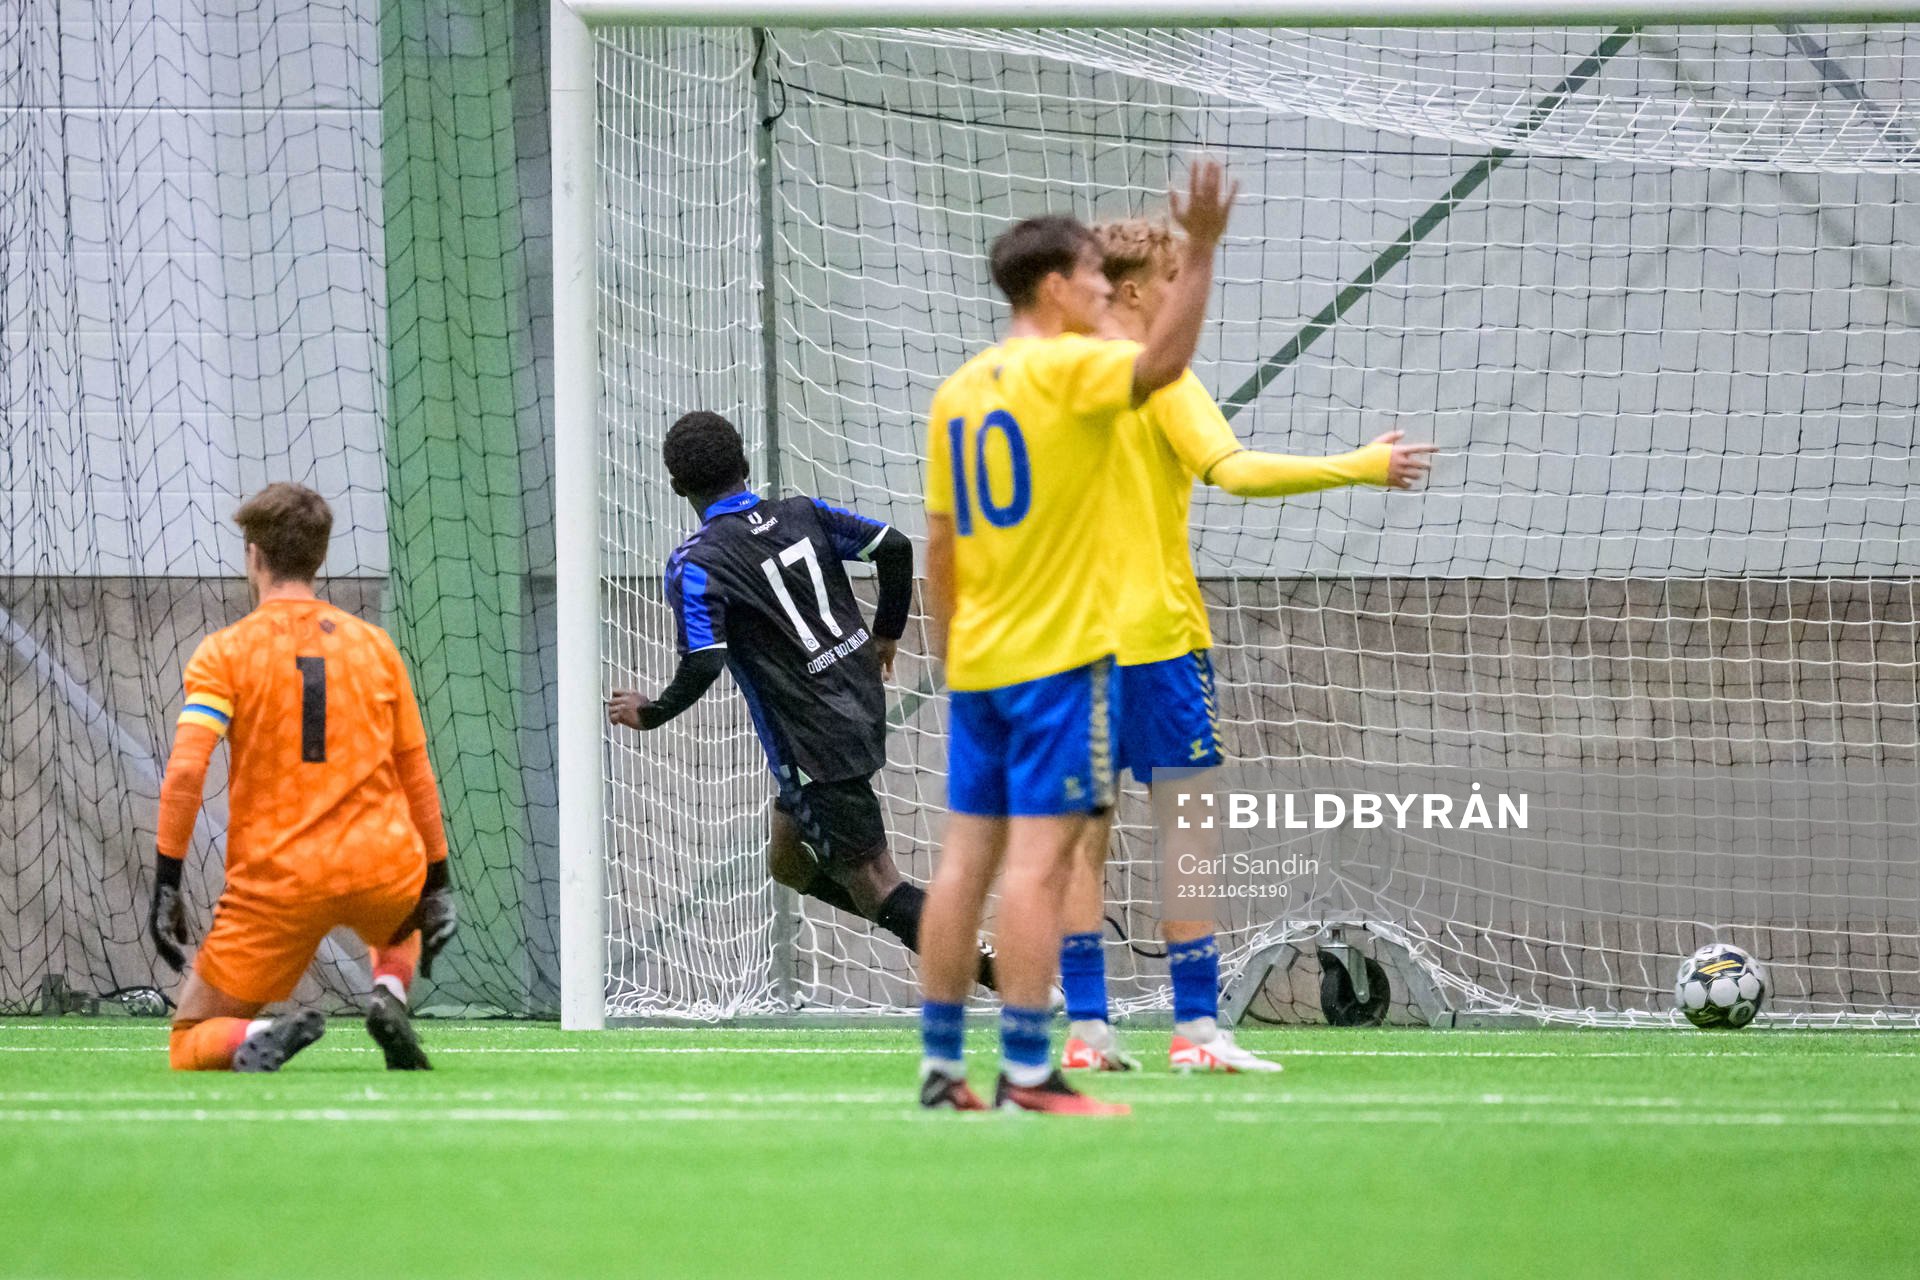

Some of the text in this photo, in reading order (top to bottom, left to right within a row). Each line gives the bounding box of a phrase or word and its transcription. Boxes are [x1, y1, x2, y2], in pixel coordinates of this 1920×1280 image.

[948, 409, 1032, 537] 10
[761, 537, 842, 652] 17
[295, 656, 327, 763] 1
